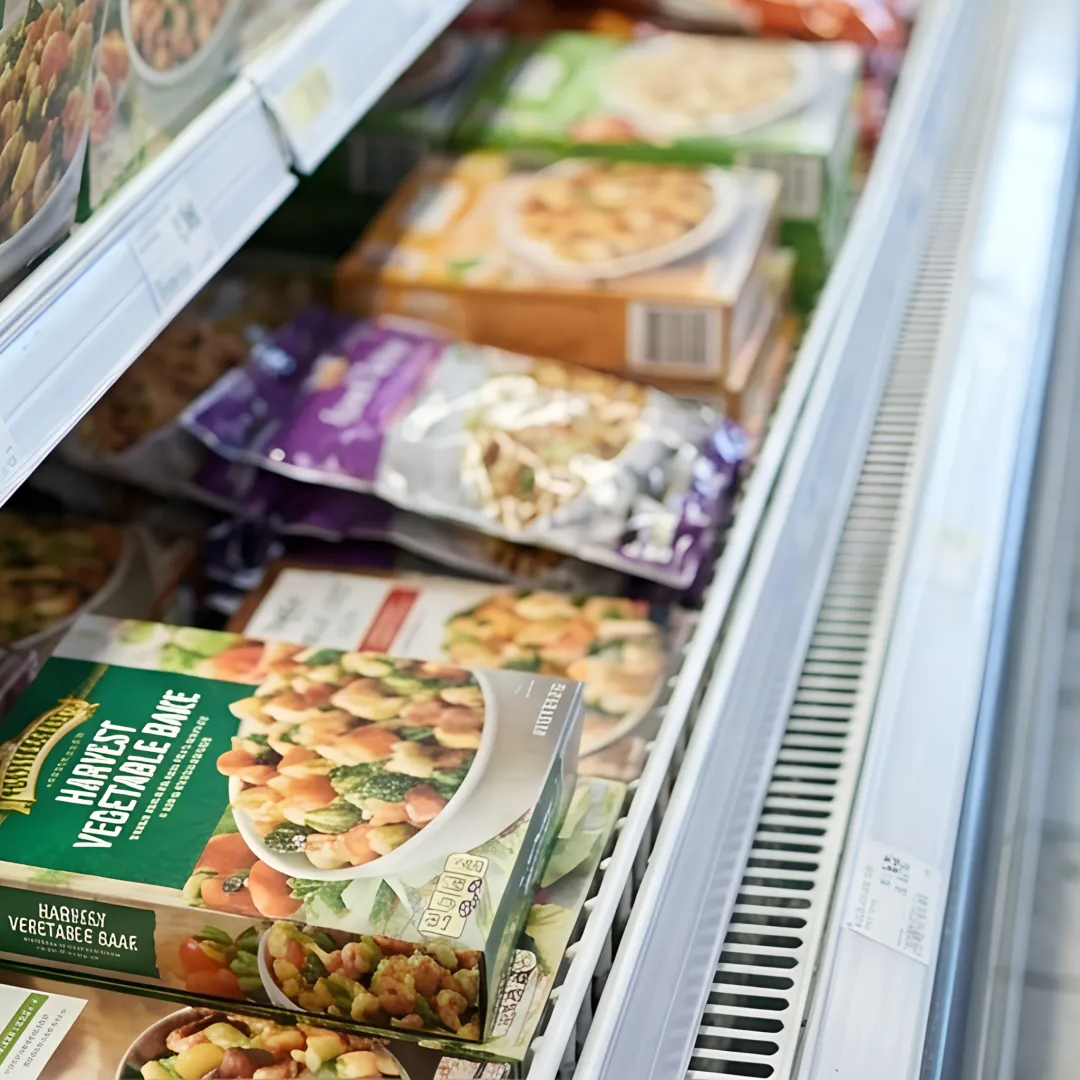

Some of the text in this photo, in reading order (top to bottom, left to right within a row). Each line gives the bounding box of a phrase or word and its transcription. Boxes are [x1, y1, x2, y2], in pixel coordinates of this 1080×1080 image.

[55, 719, 137, 806] HARVEST
[72, 739, 172, 848] VEGETABLE
[141, 689, 201, 739] BAKE
